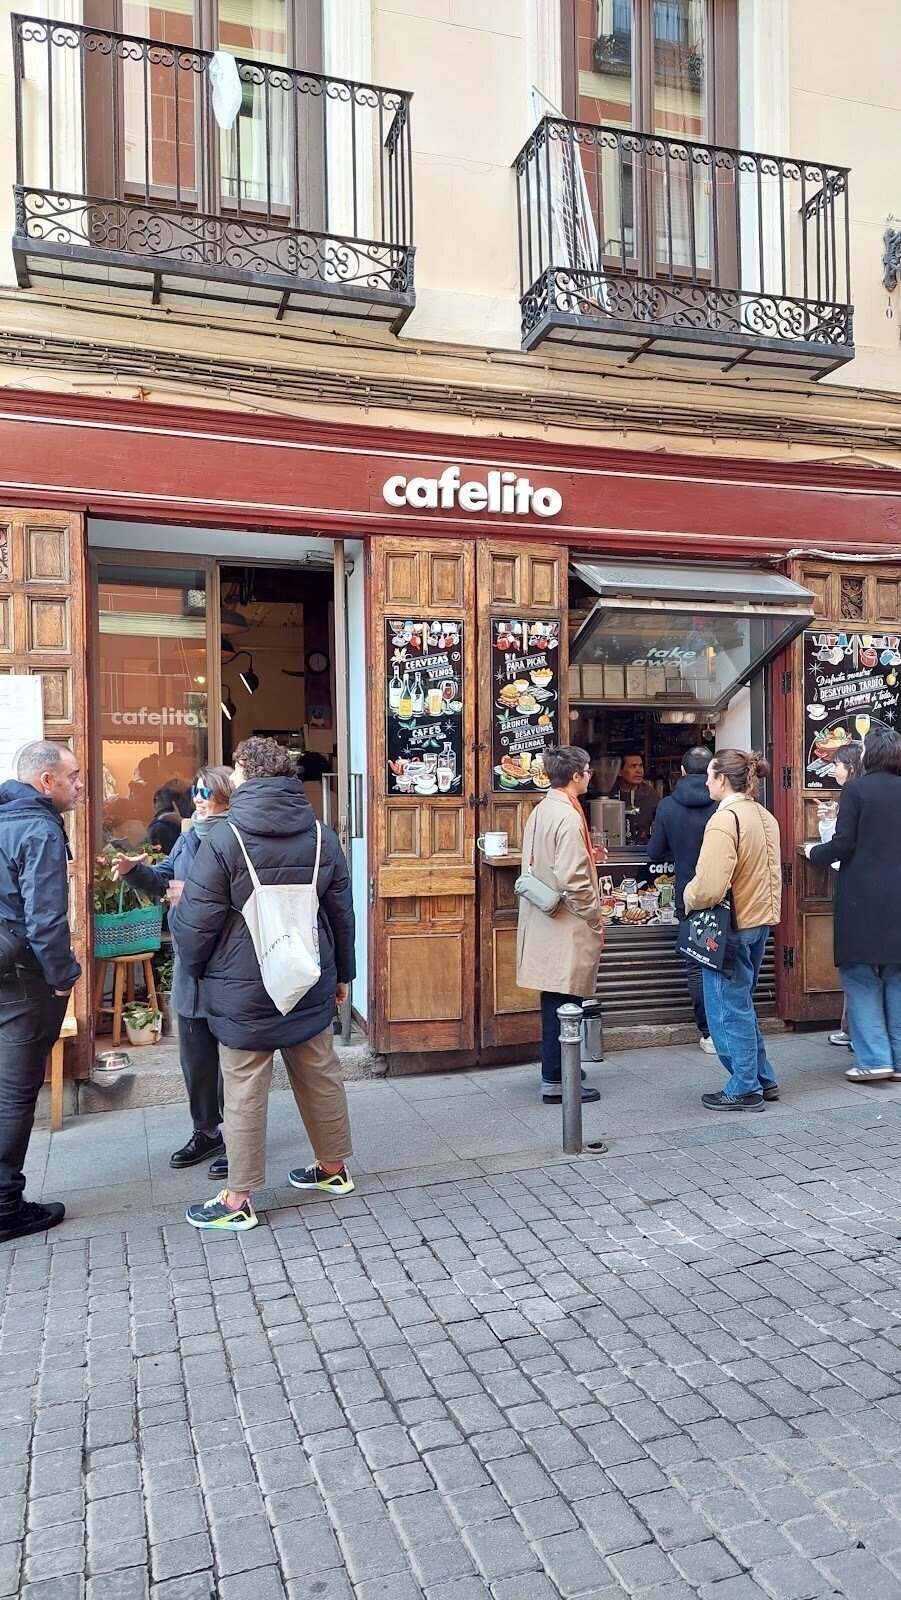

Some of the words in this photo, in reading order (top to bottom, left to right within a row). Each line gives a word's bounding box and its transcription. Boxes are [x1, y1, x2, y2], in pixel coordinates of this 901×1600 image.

[382, 466, 563, 518] cafelito
[646, 647, 697, 659] take
[405, 655, 449, 670] CERVEZAS
[506, 660, 525, 673] PARA
[526, 655, 547, 668] PICAR
[631, 659, 697, 671] away
[428, 667, 454, 679] VINOS
[820, 683, 857, 699] DESAYUNO
[111, 707, 199, 726] cafelito
[501, 718, 529, 731] BRUNCH
[514, 723, 554, 739] DESAYUNOS
[509, 738, 545, 752] MERIENDAS
